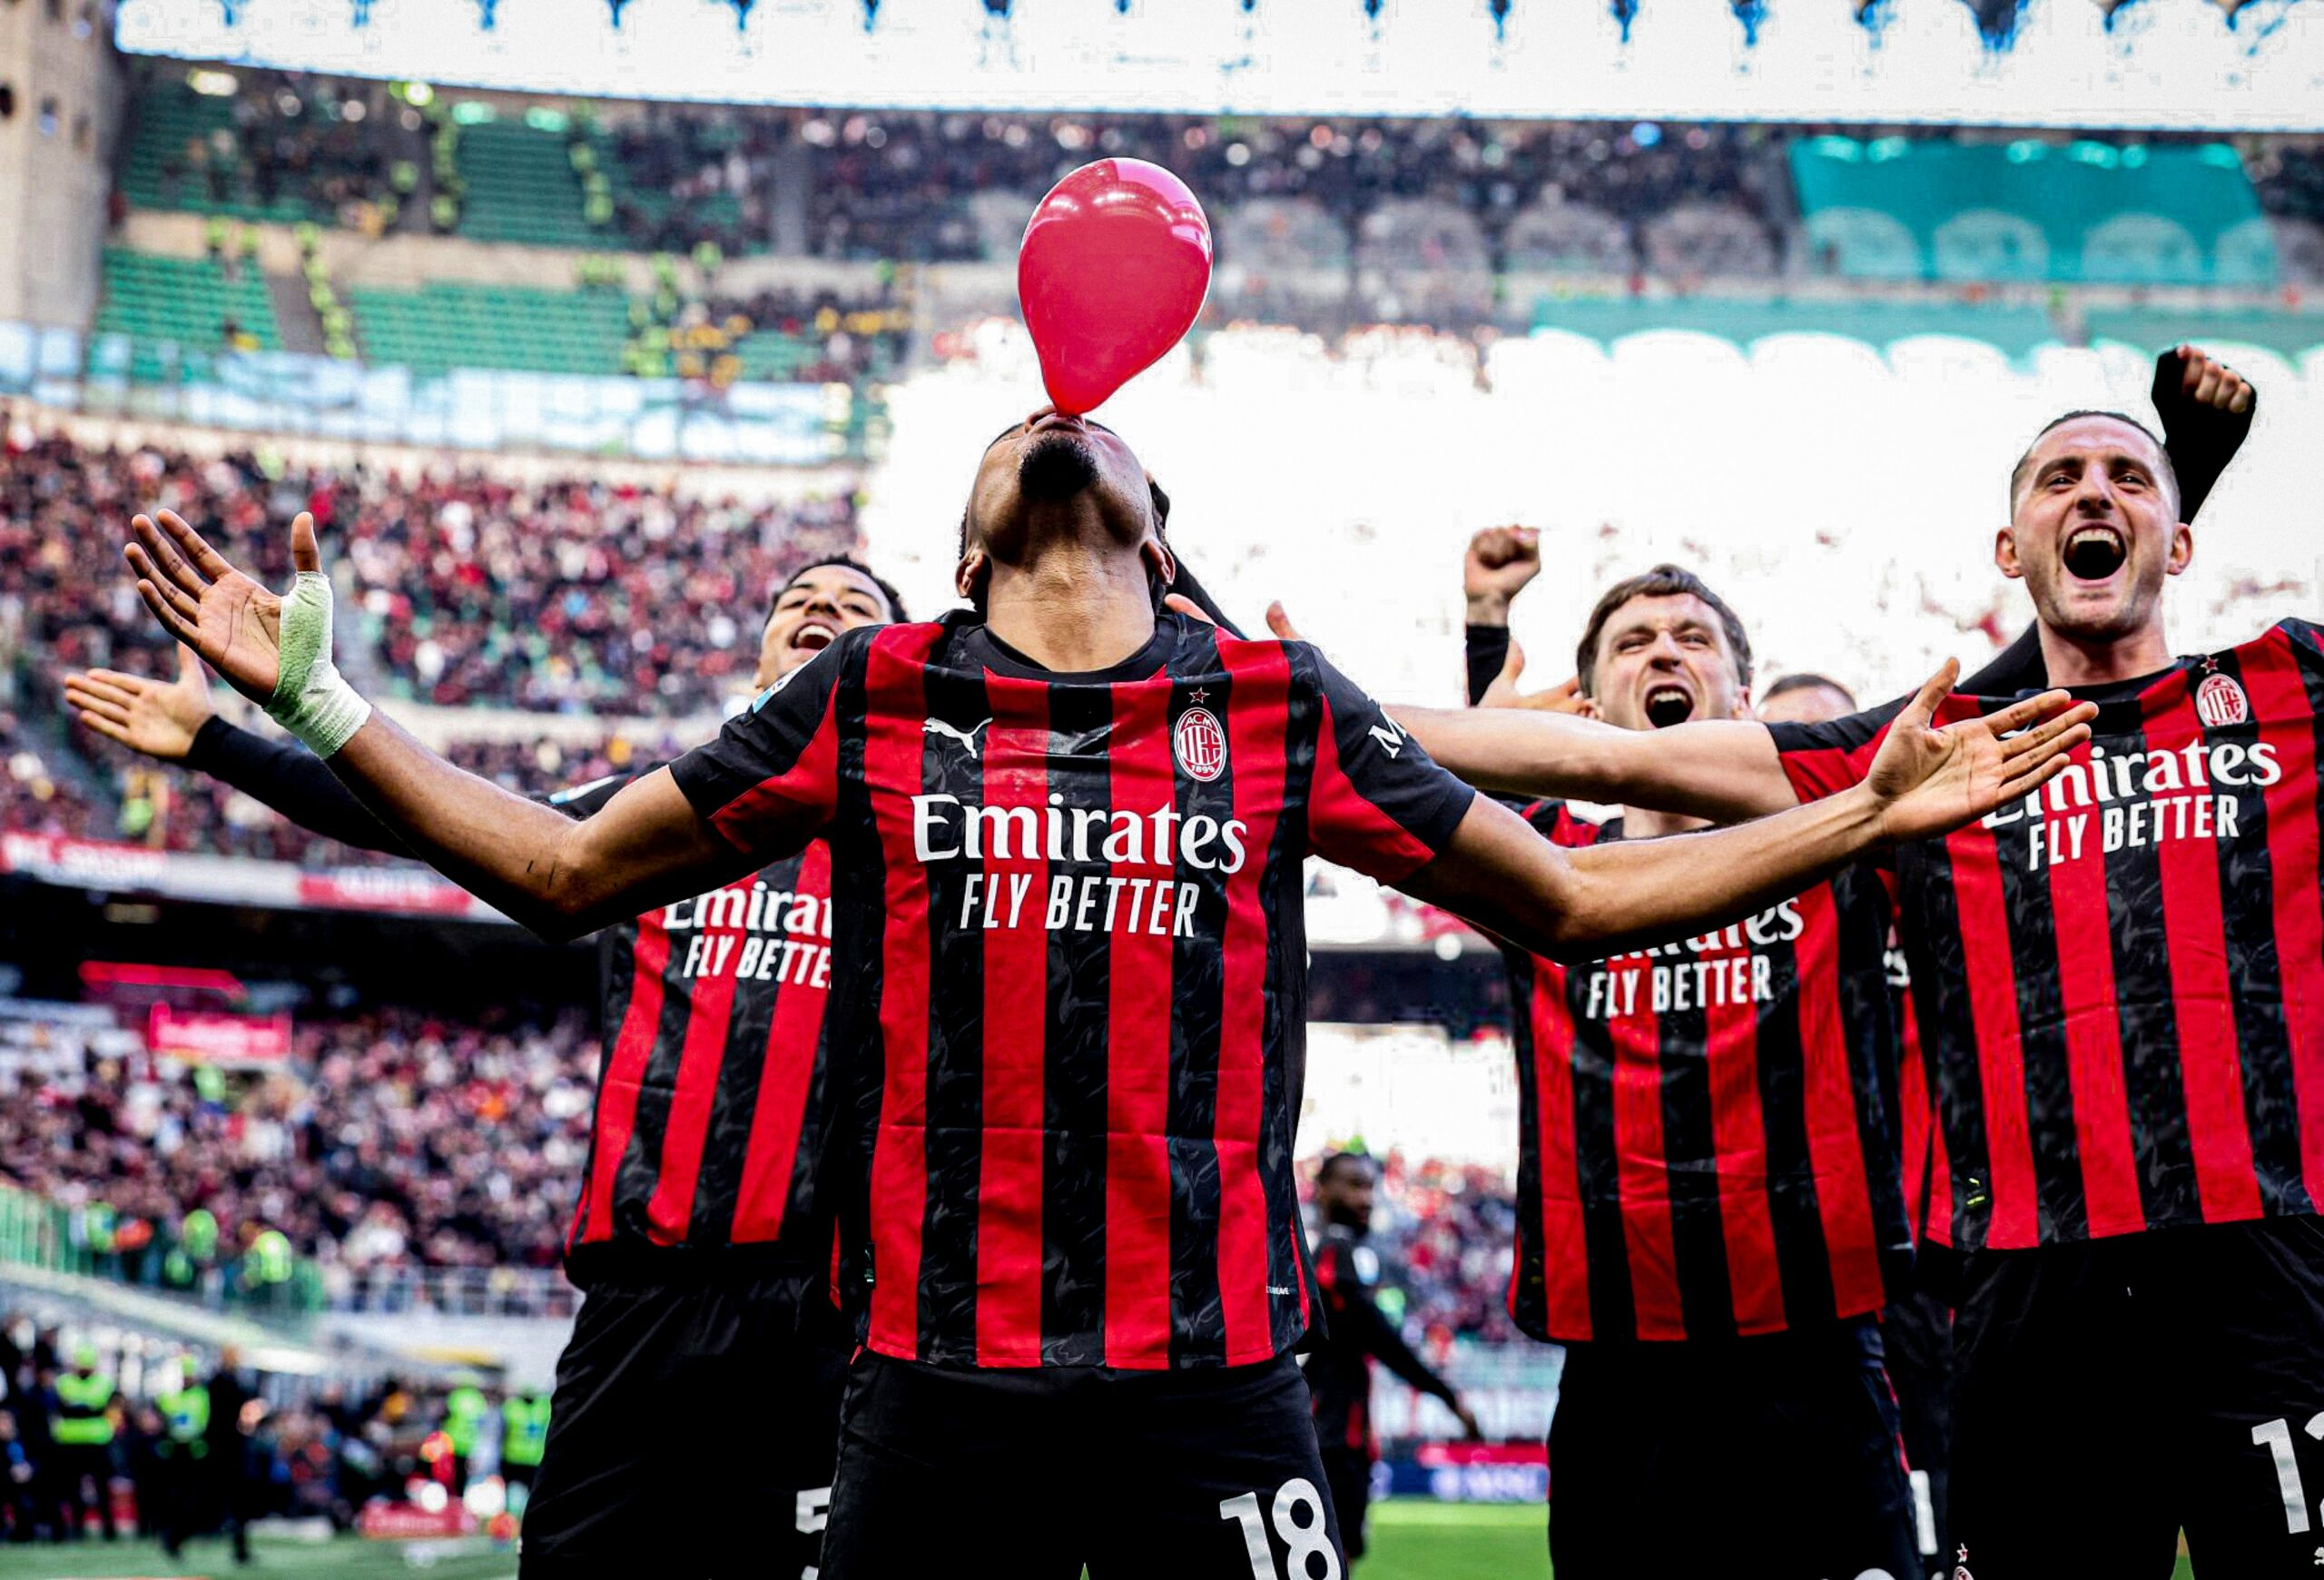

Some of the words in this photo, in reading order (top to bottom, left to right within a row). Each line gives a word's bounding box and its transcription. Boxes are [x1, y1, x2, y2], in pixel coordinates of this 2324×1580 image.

[1184, 714, 1214, 729] ACM
[1190, 764, 1216, 775] 1899
[911, 793, 1247, 874] Emirates
[2029, 813, 2088, 872] FLY
[2102, 794, 2240, 854] BETTER
[960, 874, 1032, 930] FLY
[1044, 874, 1201, 938] BETTER
[682, 934, 735, 978] FLY
[734, 935, 832, 991] BETTE
[1586, 967, 1640, 1020] FLY
[1650, 954, 1774, 1013] BETTER
[1219, 1477, 1342, 1580] 18
